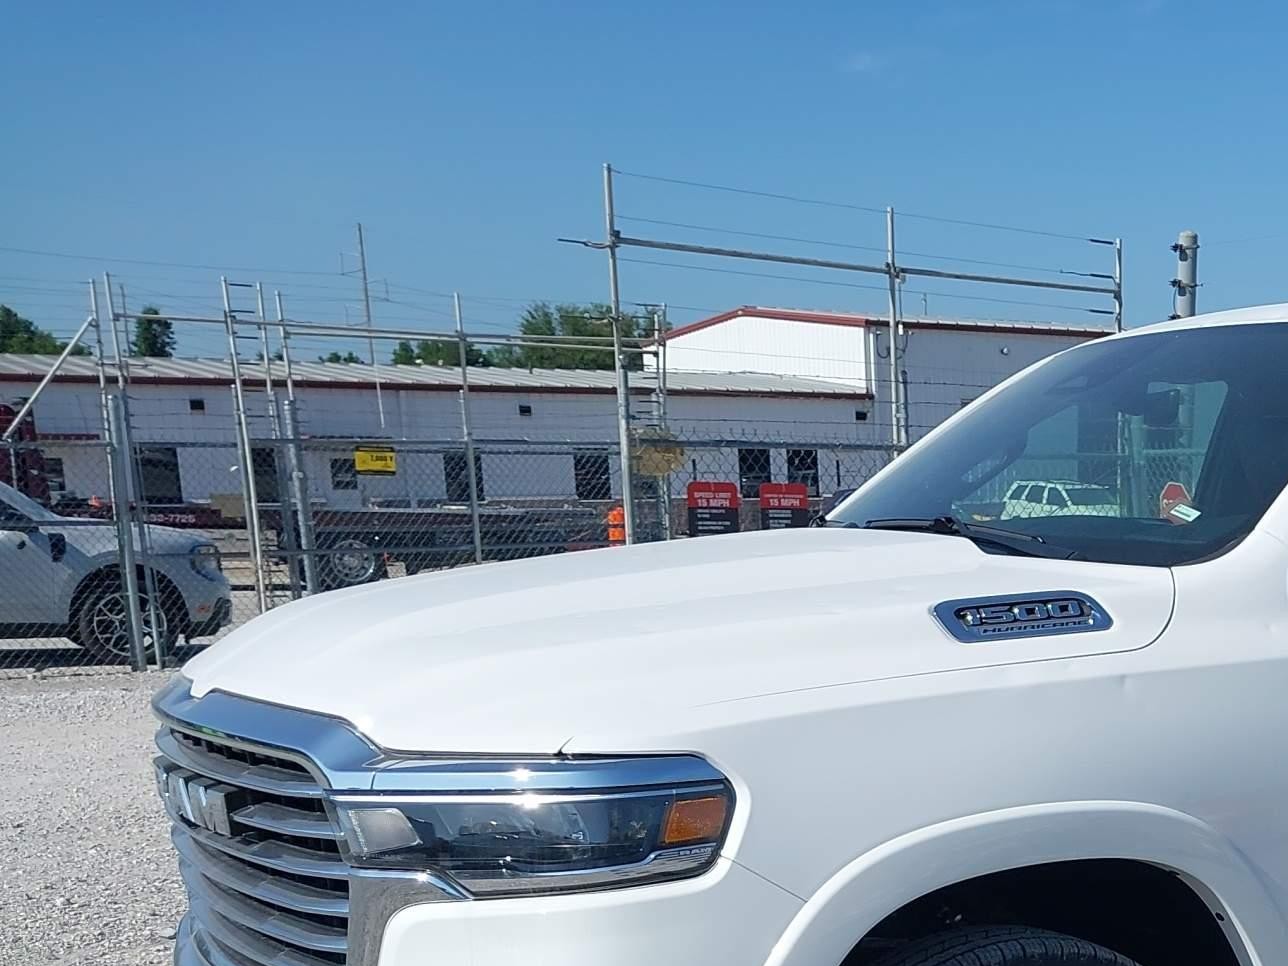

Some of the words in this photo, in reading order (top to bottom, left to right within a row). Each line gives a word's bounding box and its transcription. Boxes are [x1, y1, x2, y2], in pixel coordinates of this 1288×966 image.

[698, 499, 708, 507] 15
[709, 499, 730, 507] MPH
[769, 499, 779, 507] 15
[780, 499, 800, 507] MPH
[960, 600, 1081, 627] 1500
[982, 620, 1089, 634] HURRICANE
